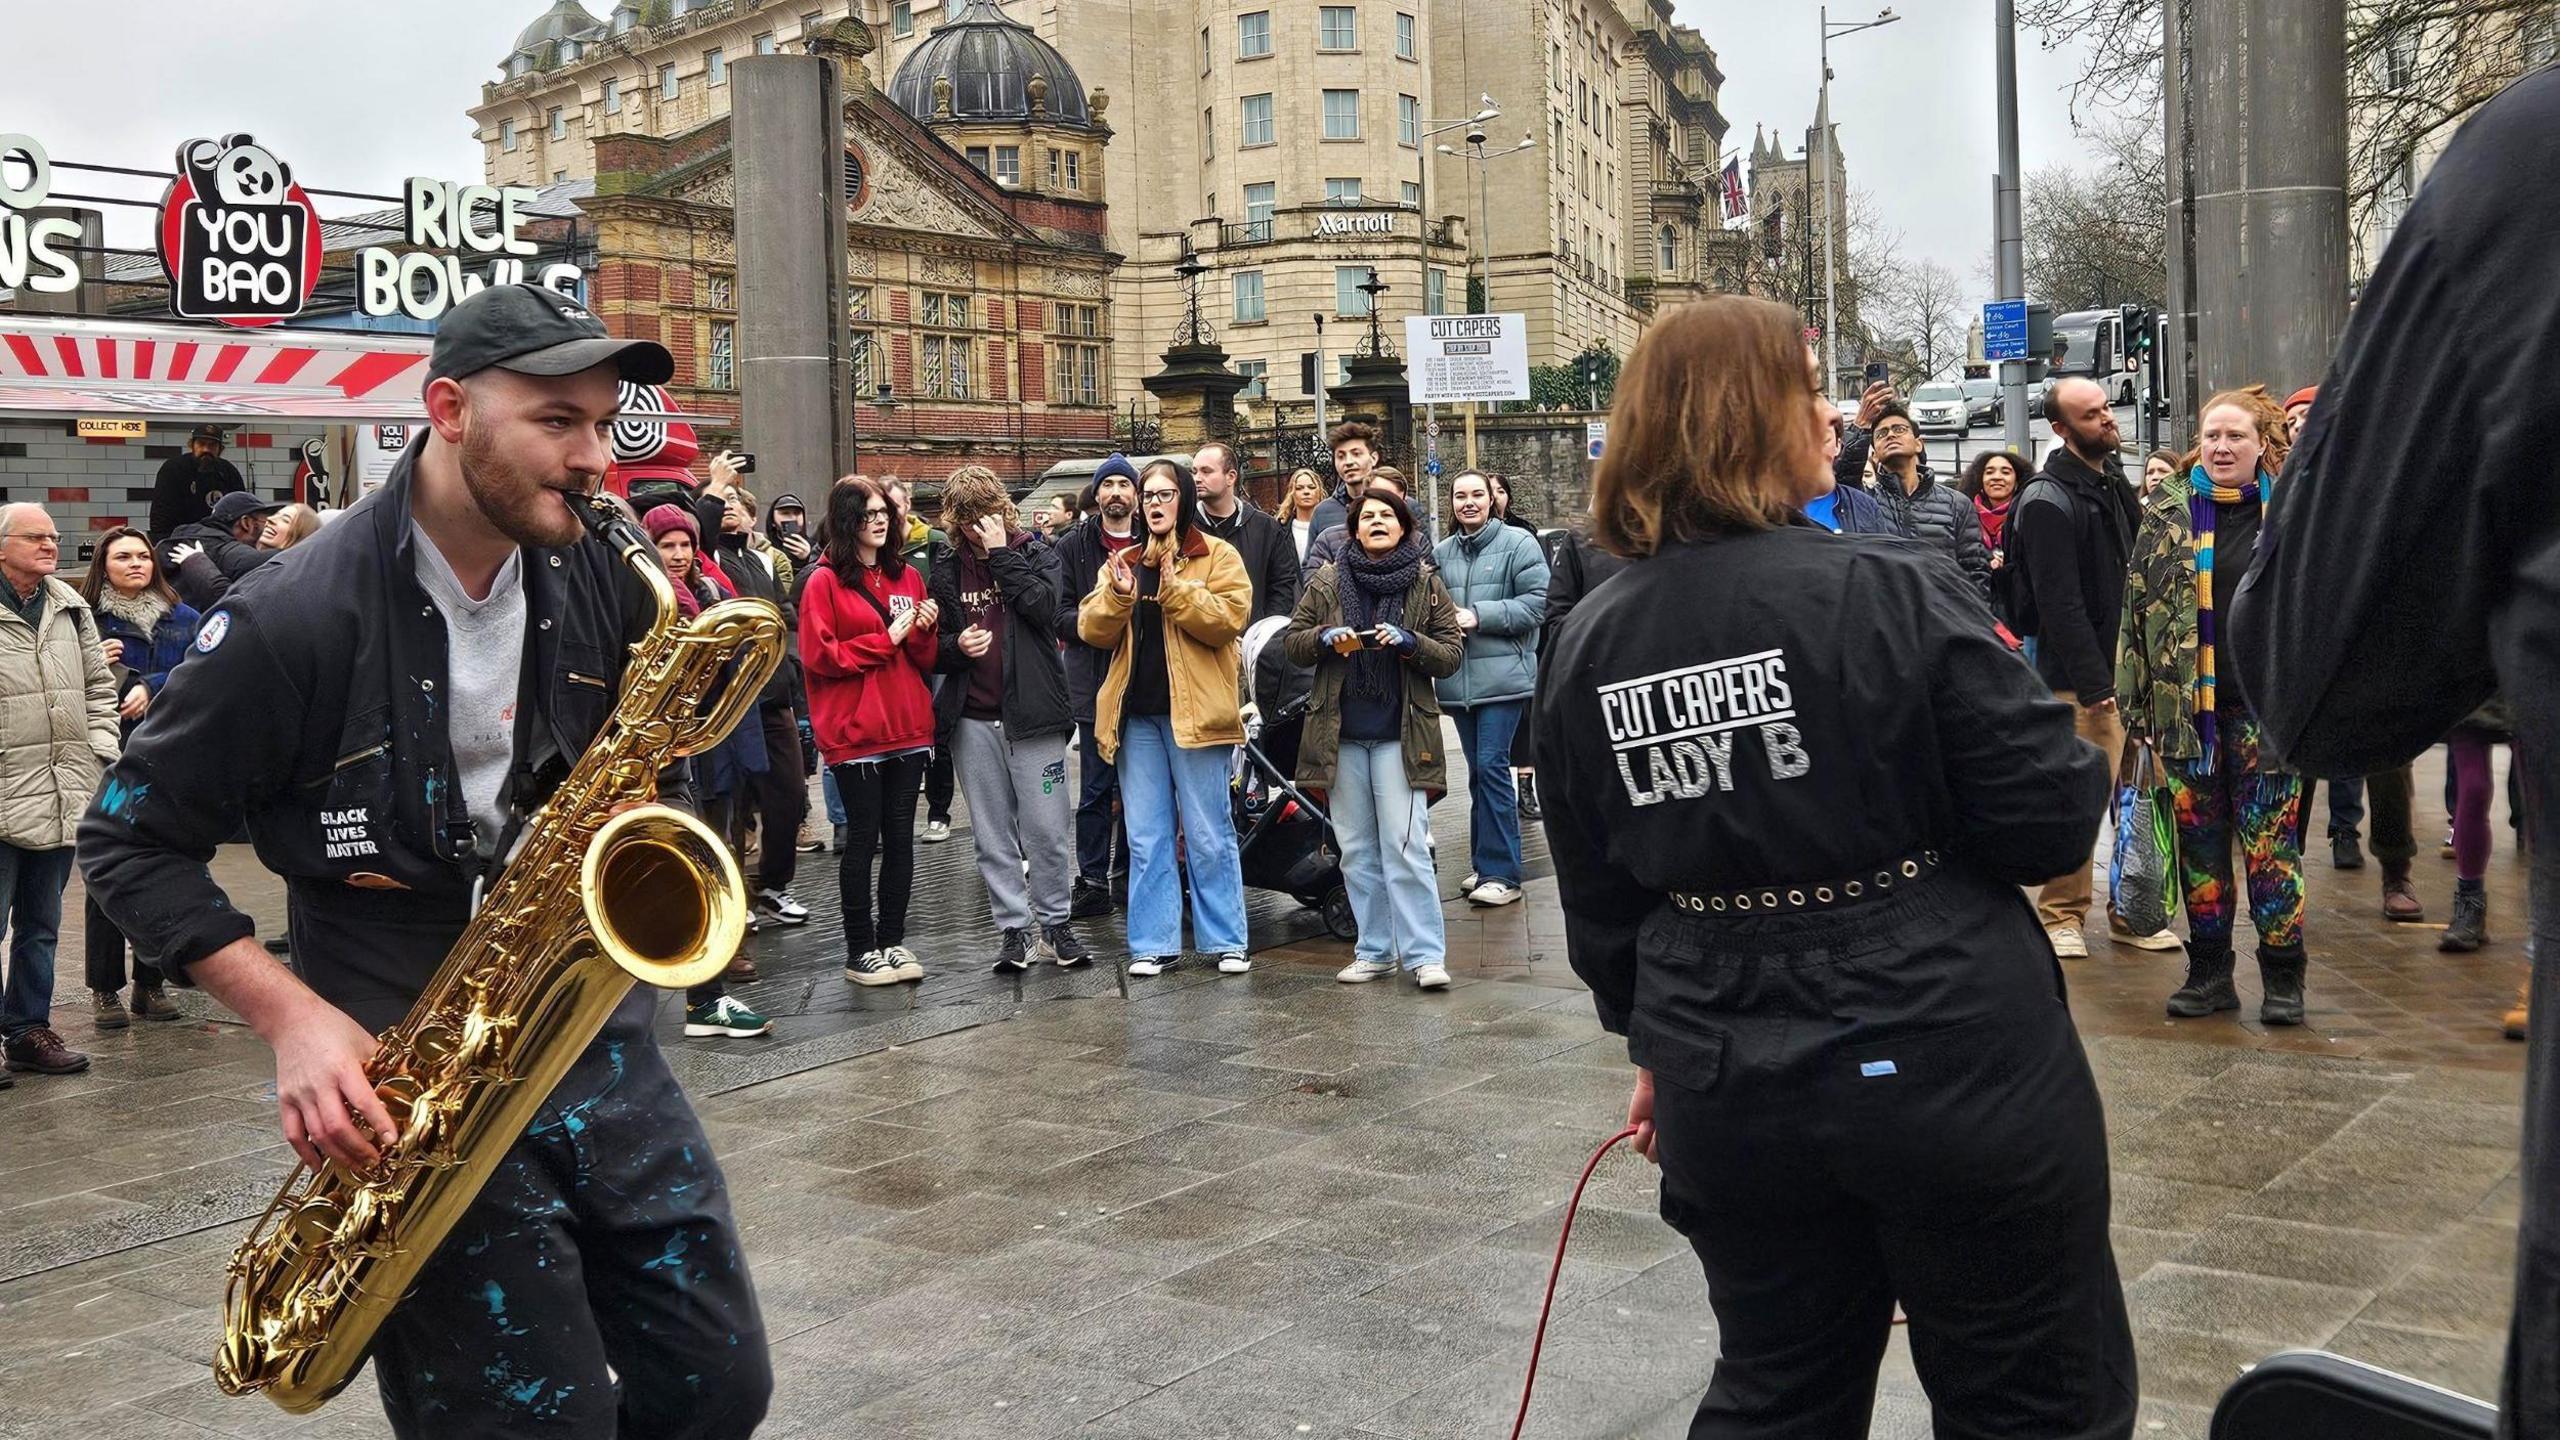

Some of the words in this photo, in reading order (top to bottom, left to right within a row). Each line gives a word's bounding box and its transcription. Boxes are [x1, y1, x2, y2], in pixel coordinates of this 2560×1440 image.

[405, 177, 539, 255] RICE
[1312, 212, 1393, 236] Marriott
[197, 208, 291, 257] YOU
[203, 257, 292, 306] BAO
[1431, 321, 1453, 337] CUT
[1456, 319, 1501, 336] CAPERS
[79, 422, 118, 432] COLLECT
[121, 423, 142, 432] HERE
[381, 425, 403, 436] YOU
[382, 437, 403, 448] BAO
[1600, 685, 1658, 742] CUT
[1662, 657, 1793, 729] CAPERS
[1616, 731, 1735, 807] LADY
[1759, 722, 1812, 781] B
[320, 808, 369, 825] BLACK
[326, 825, 368, 842] LIVES
[326, 840, 380, 858] MATTER
